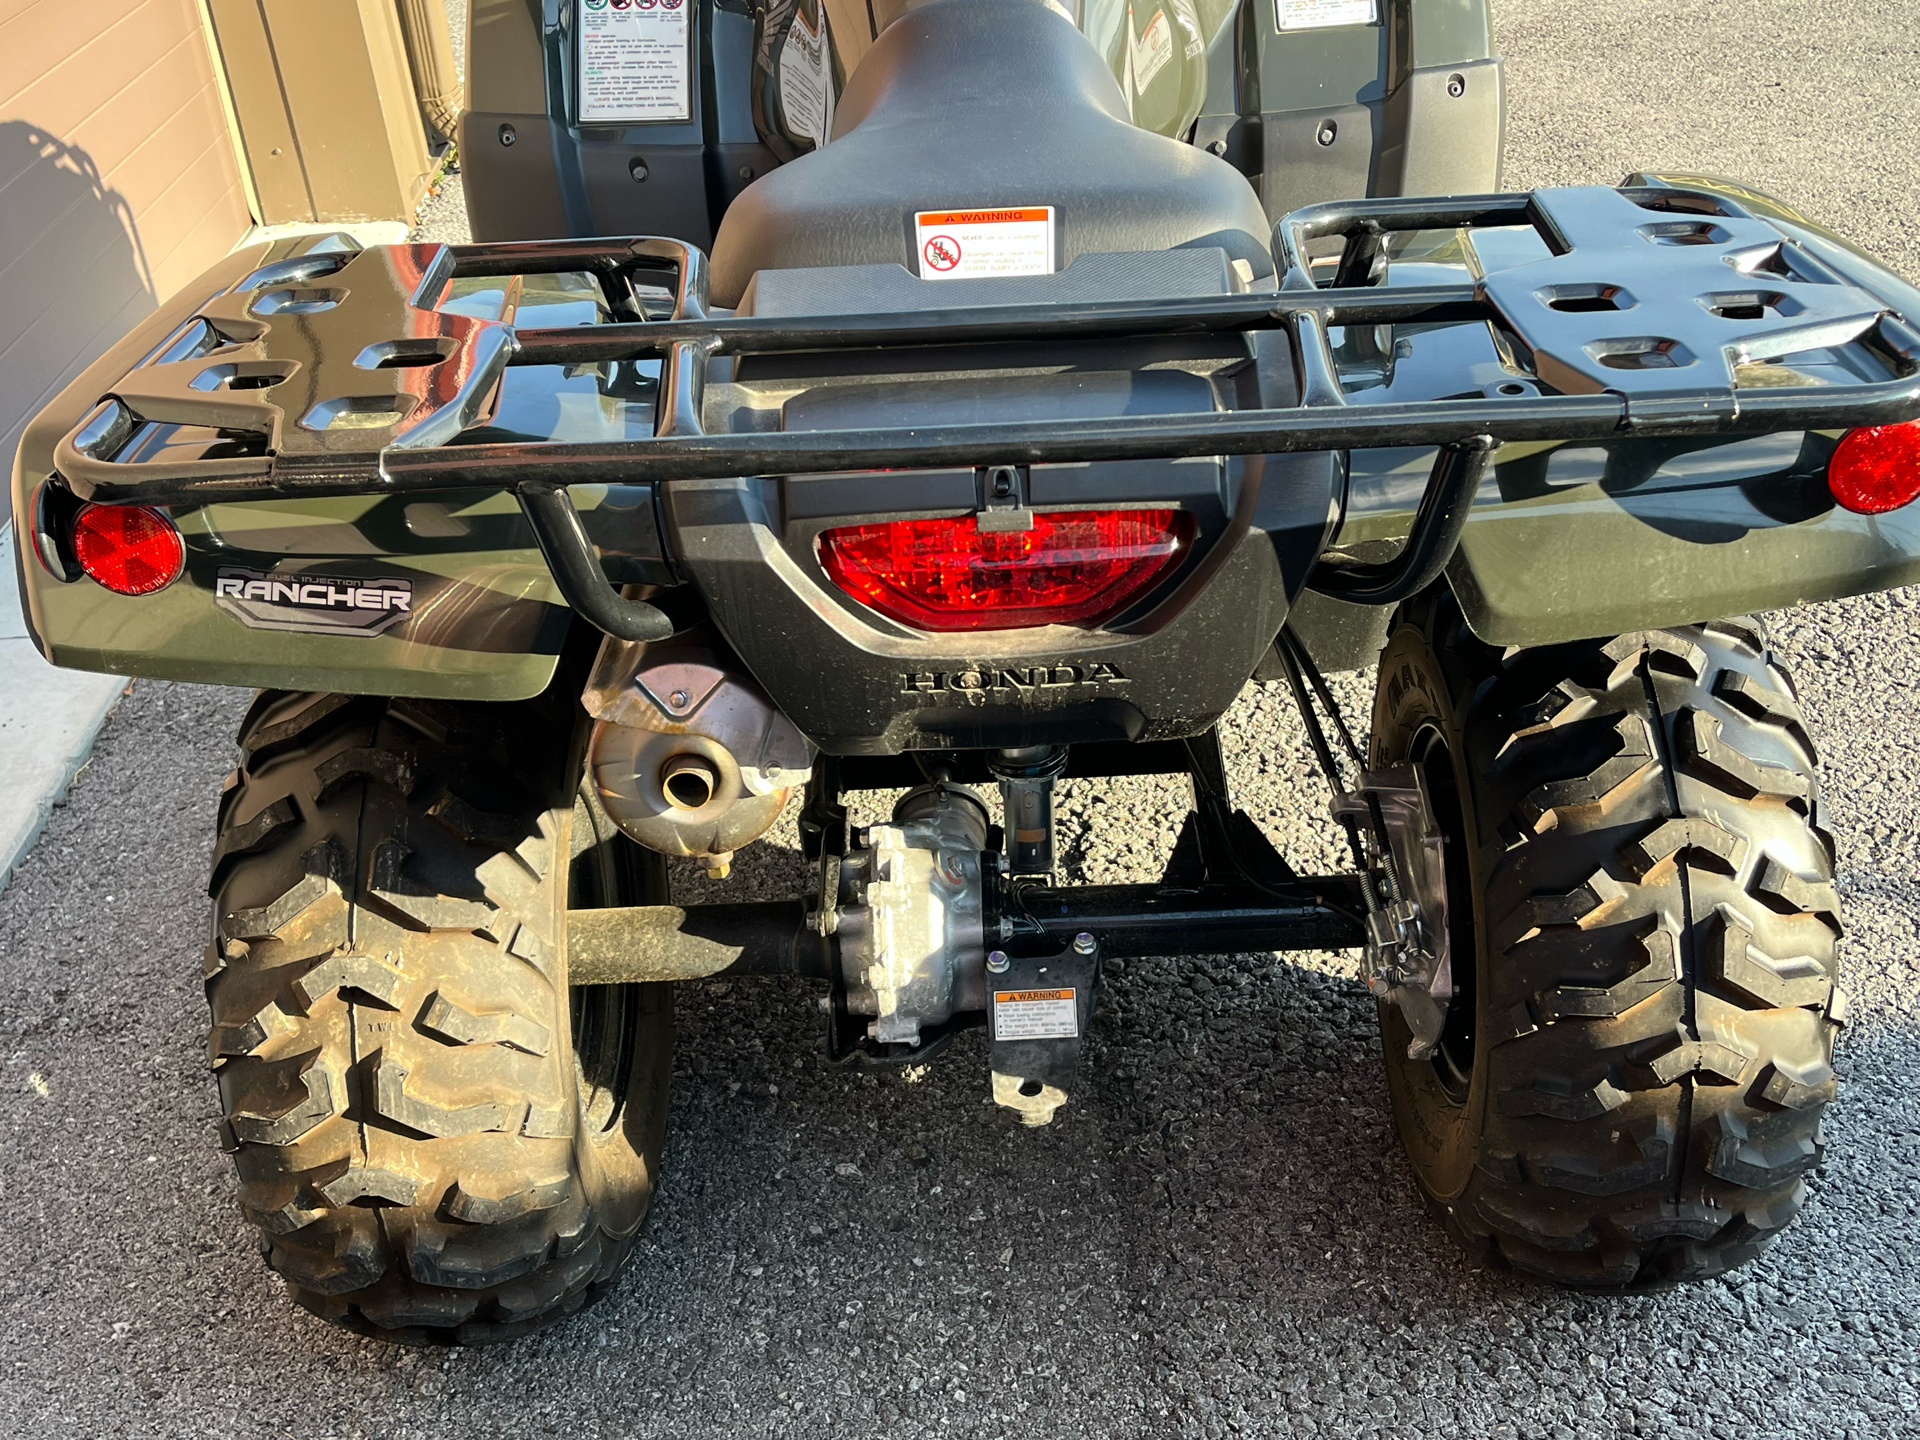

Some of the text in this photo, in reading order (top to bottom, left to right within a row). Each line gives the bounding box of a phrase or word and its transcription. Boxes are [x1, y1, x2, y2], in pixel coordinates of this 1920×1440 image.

[961, 212, 1023, 222] WARNING
[266, 573, 361, 586] FUEL INJECTION
[216, 578, 411, 611] RANCHER
[898, 662, 1133, 694] HONDA
[1018, 991, 1062, 1000] WARNING
